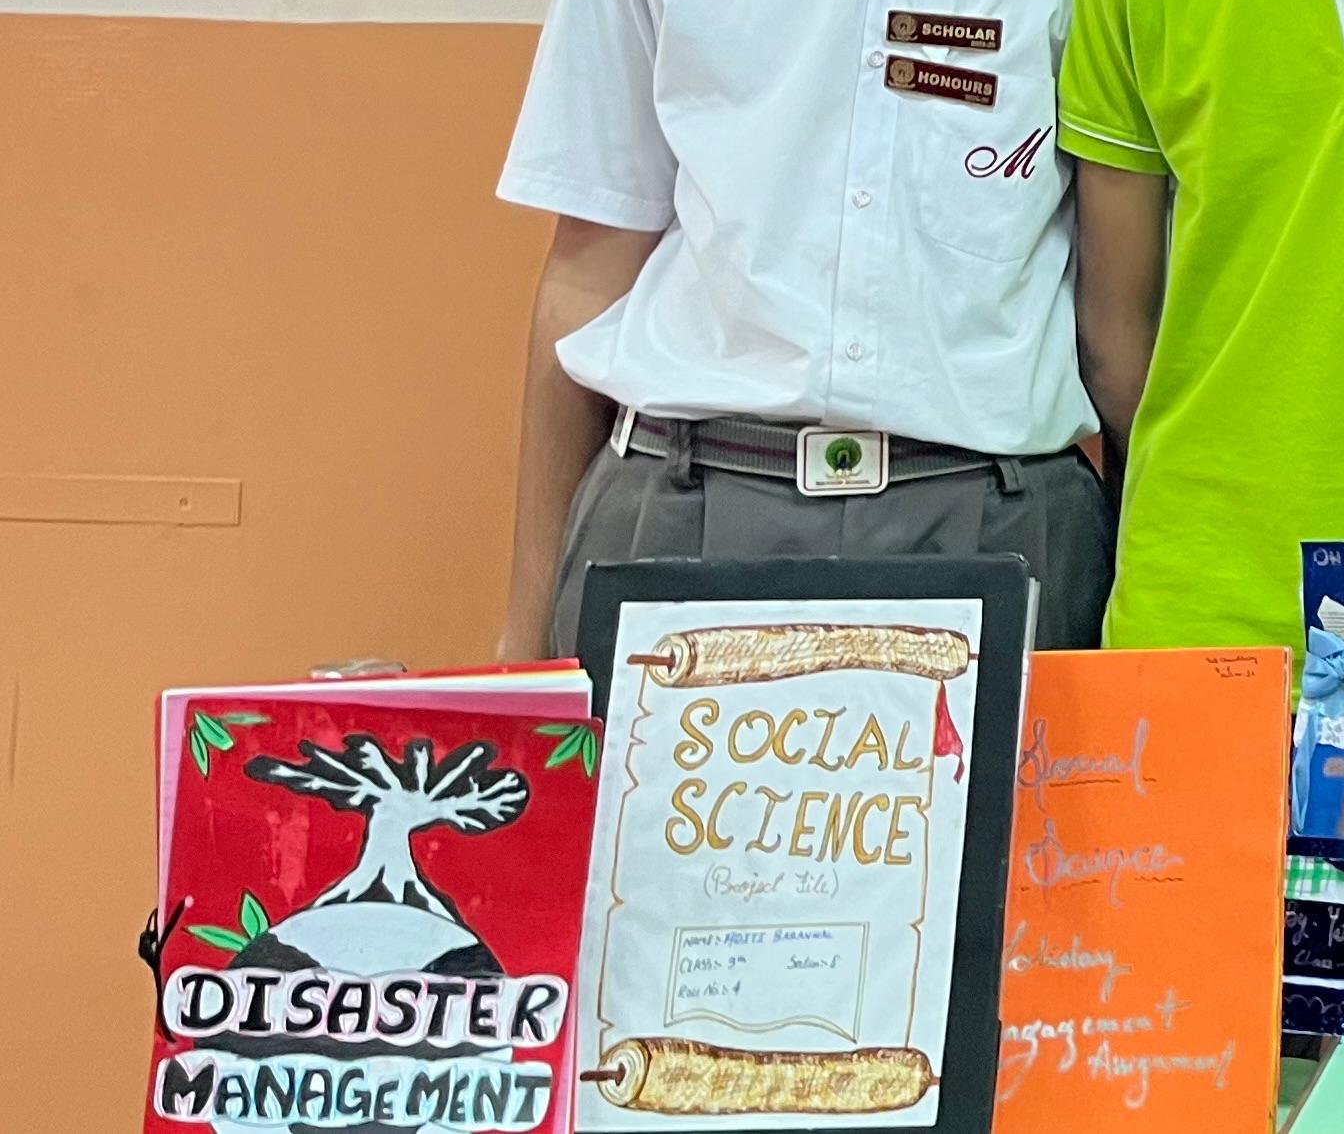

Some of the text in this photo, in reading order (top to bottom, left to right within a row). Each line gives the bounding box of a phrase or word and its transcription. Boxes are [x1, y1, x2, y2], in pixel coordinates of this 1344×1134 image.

[921, 22, 997, 42] SCHOLAR
[917, 70, 994, 97] HONOURS
[672, 696, 932, 774] SOCIAL
[664, 776, 927, 866] SCIENCE
[179, 971, 561, 1044] DISASTER
[161, 1057, 553, 1126] MANAGEMENT
